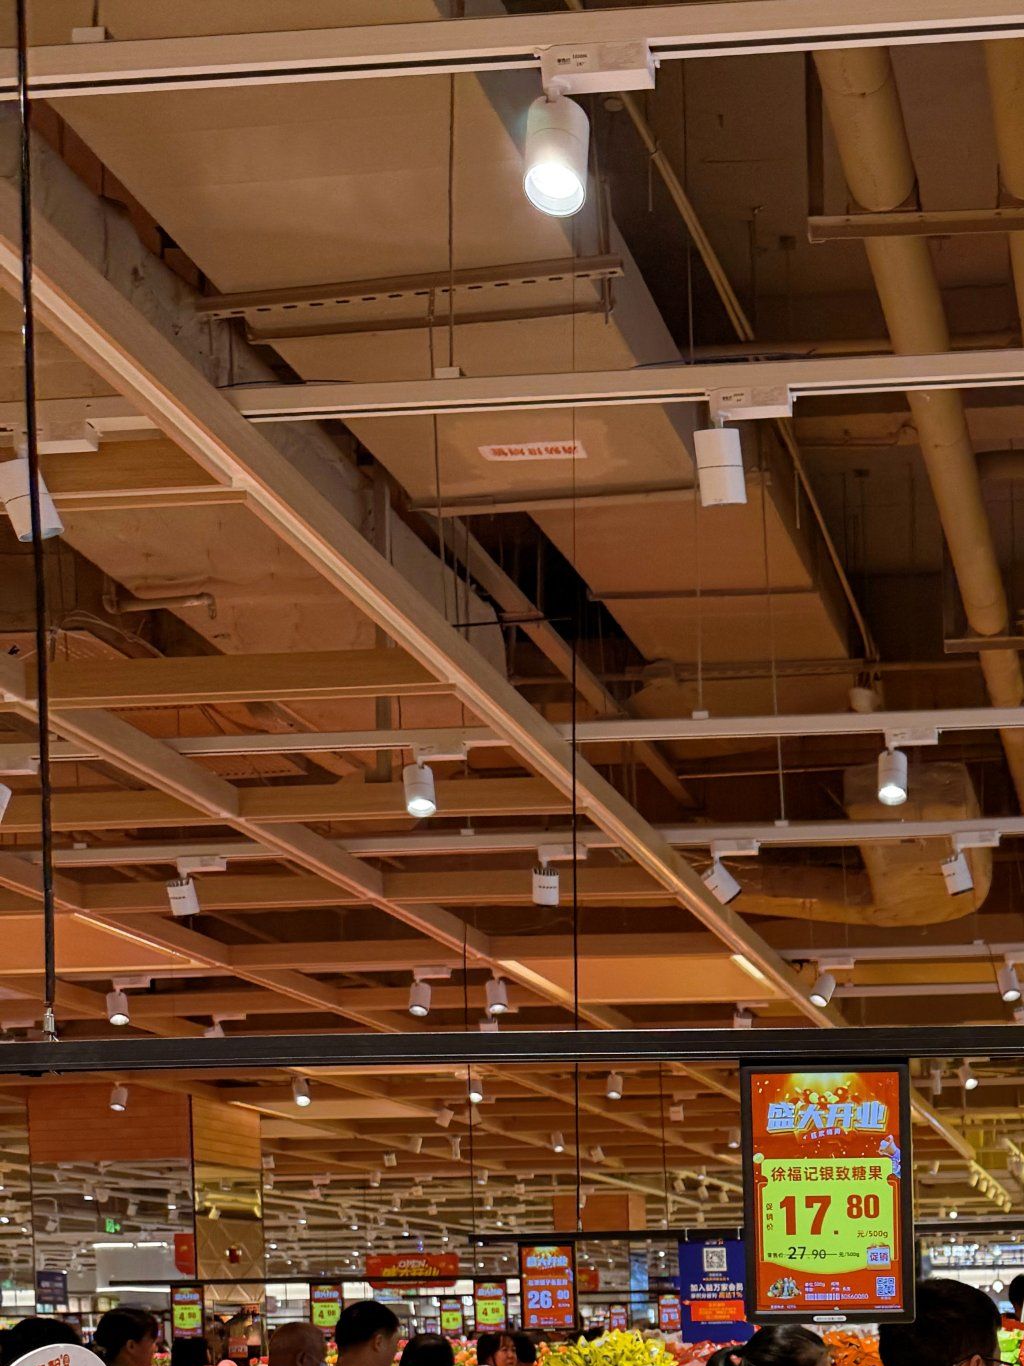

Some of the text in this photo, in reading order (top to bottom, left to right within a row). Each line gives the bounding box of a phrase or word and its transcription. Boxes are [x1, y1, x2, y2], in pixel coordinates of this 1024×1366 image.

[766, 1101, 887, 1131] 盛大开业
[771, 1166, 883, 1182] 徐福记银致糖果
